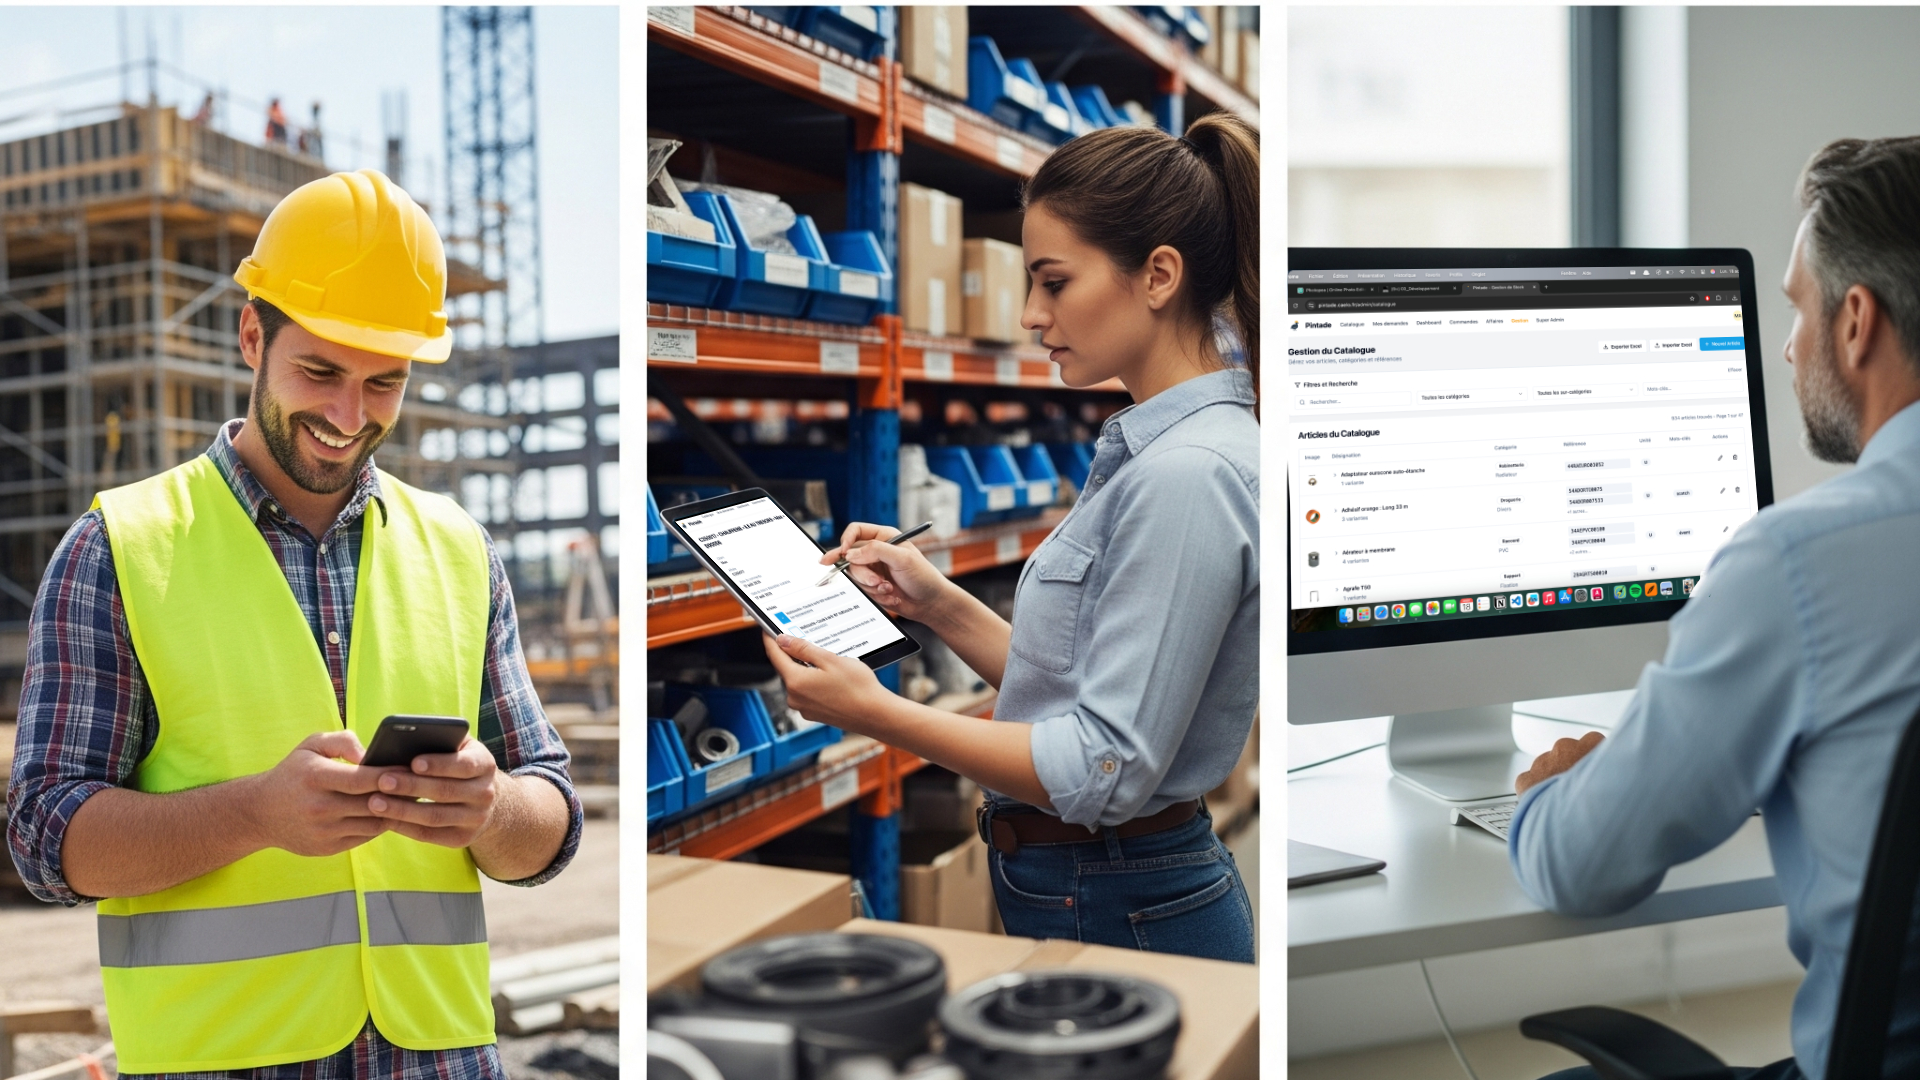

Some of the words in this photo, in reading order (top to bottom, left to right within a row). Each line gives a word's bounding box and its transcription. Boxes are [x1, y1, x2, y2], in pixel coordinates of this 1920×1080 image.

[1288, 347, 1320, 356] Gestion
[1322, 347, 1333, 355] du
[1334, 346, 1376, 355] Catalogue
[1298, 431, 1328, 439] Articles
[1329, 430, 1340, 438] du
[1340, 429, 1380, 438] Catalogue
